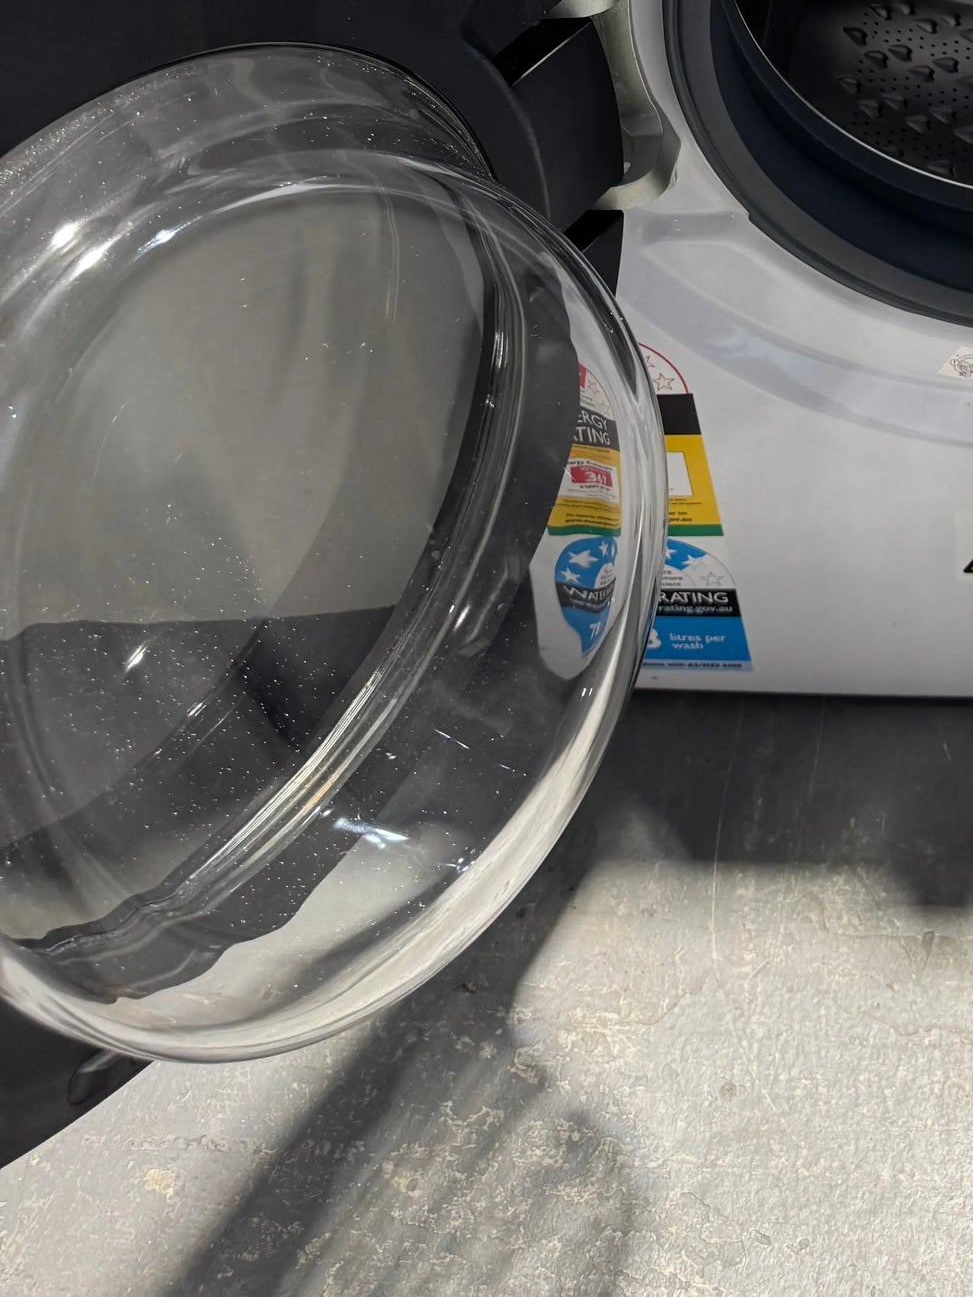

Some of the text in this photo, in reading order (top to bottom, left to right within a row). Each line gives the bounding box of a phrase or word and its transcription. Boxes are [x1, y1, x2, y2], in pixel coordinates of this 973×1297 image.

[659, 591, 729, 603] RATING
[659, 604, 733, 614] rating.gov.au
[669, 632, 727, 644] litres per
[672, 641, 704, 650] wash
